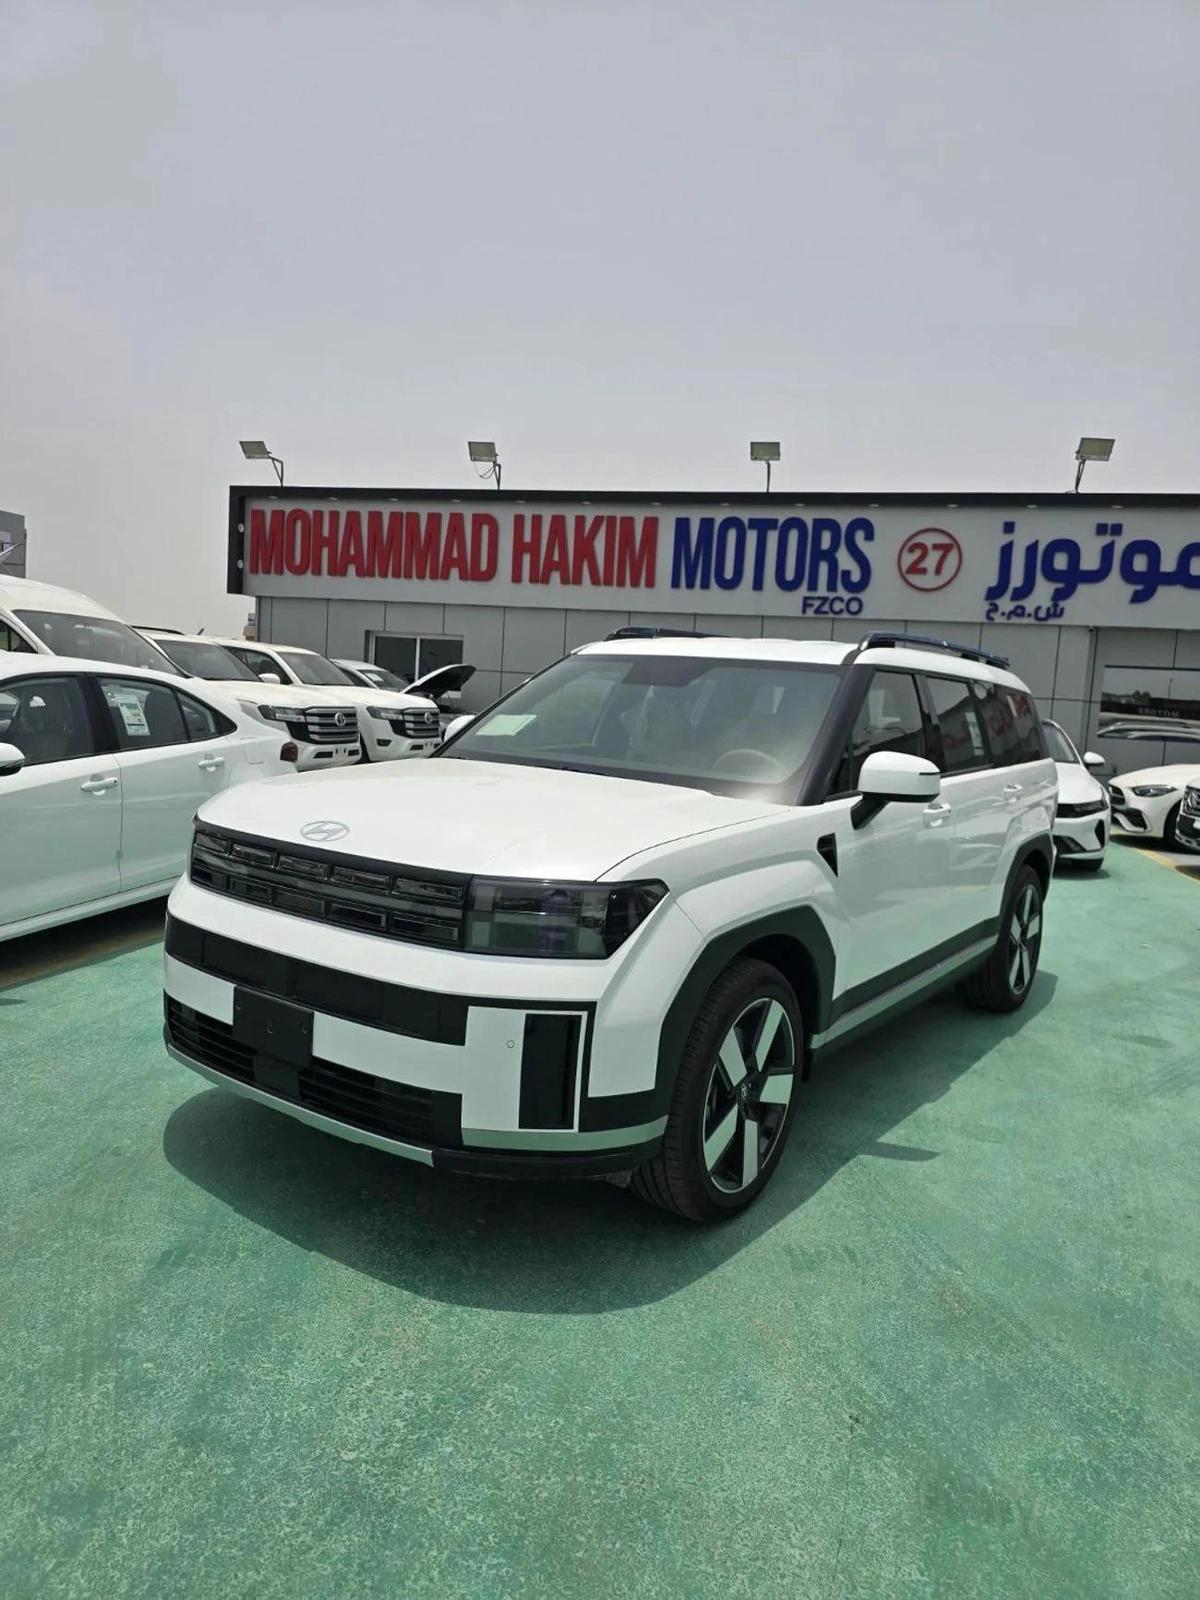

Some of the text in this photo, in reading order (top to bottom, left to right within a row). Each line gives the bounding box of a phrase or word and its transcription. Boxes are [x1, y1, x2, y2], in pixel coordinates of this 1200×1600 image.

[249, 508, 955, 594] MOHAMMAD HAKIM MOTORS 27
[801, 597, 864, 616] FZCO
